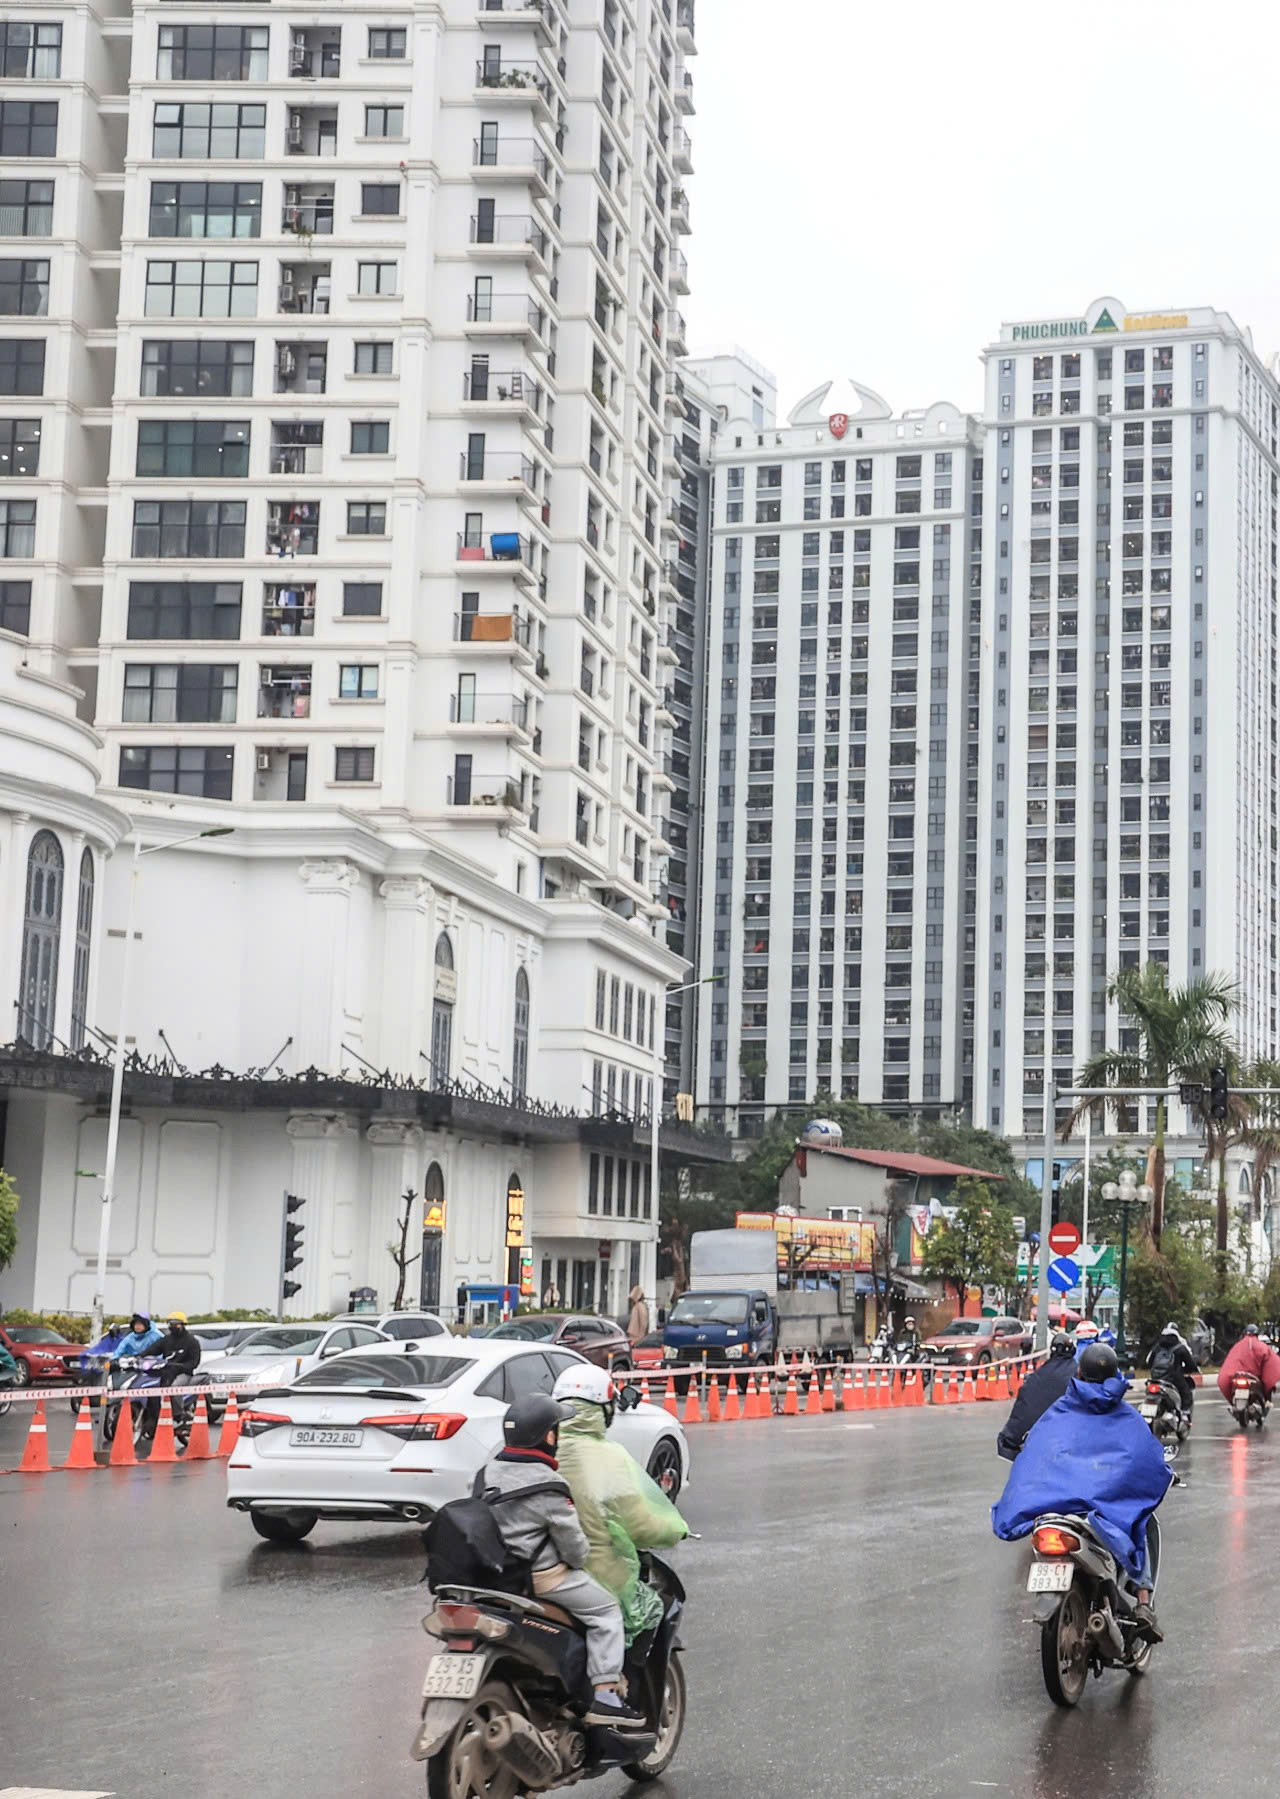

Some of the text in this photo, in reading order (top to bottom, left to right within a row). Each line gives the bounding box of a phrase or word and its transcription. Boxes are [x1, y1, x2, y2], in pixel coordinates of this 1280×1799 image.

[1012, 320, 1088, 341] PHUCHUNG
[296, 1432, 356, 1443] 90A-232.80
[1037, 1564, 1067, 1576] 99-C1
[425, 1677, 474, 1694] 532.50
